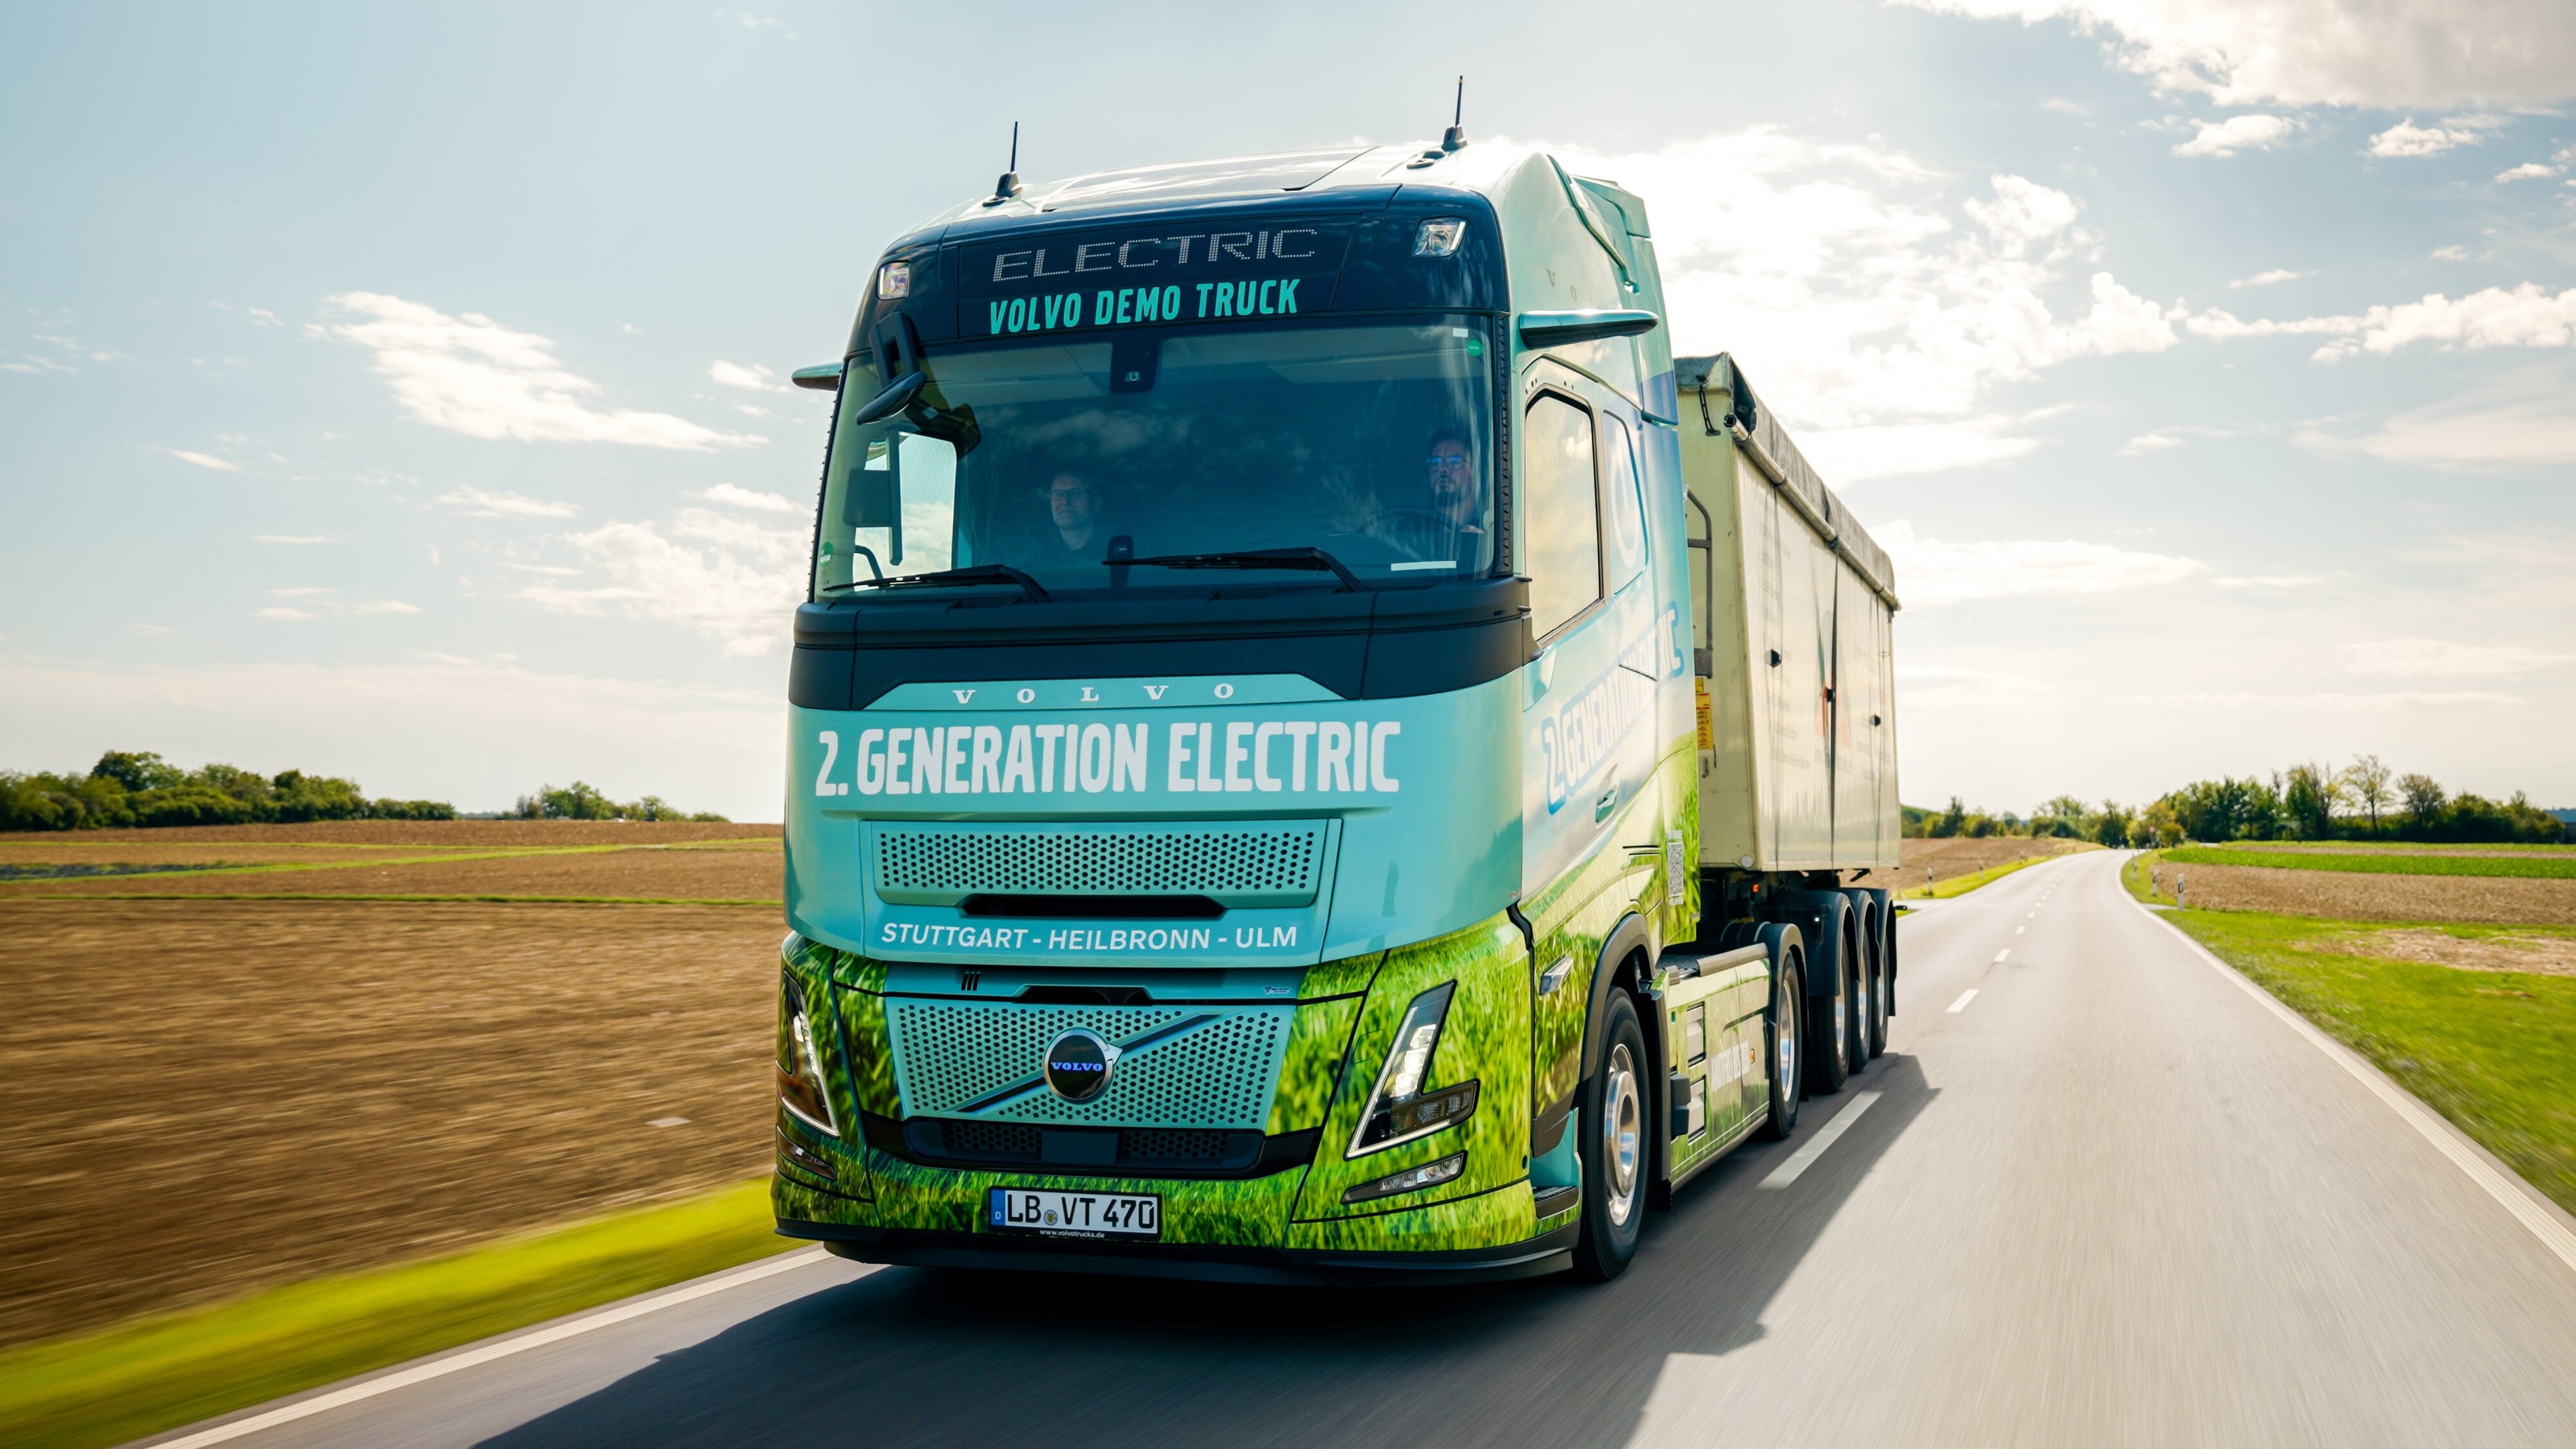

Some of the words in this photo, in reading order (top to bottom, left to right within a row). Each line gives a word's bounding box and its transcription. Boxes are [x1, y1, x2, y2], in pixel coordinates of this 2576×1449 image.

[993, 228, 1318, 282] ELECTRIC
[990, 292, 1082, 334] VOLVO
[1095, 285, 1181, 325] DEMO
[1196, 279, 1301, 317] TRUCK
[952, 683, 1235, 705] VOLVO
[815, 730, 848, 796] 2.
[857, 722, 1149, 795] GENERATION
[1167, 720, 1402, 793] ELECTRIC
[882, 923, 1029, 948] STUTTGART
[1048, 929, 1211, 951] HEILBRONN
[1236, 926, 1298, 948] ULM
[1051, 1062, 1104, 1072] VOLVO
[995, 1211, 1001, 1220] D
[1007, 1194, 1042, 1224] LB
[1061, 1196, 1096, 1226] VT
[1103, 1199, 1154, 1229] 470
[1039, 1228, 1105, 1239] www.volvotrucks.de
